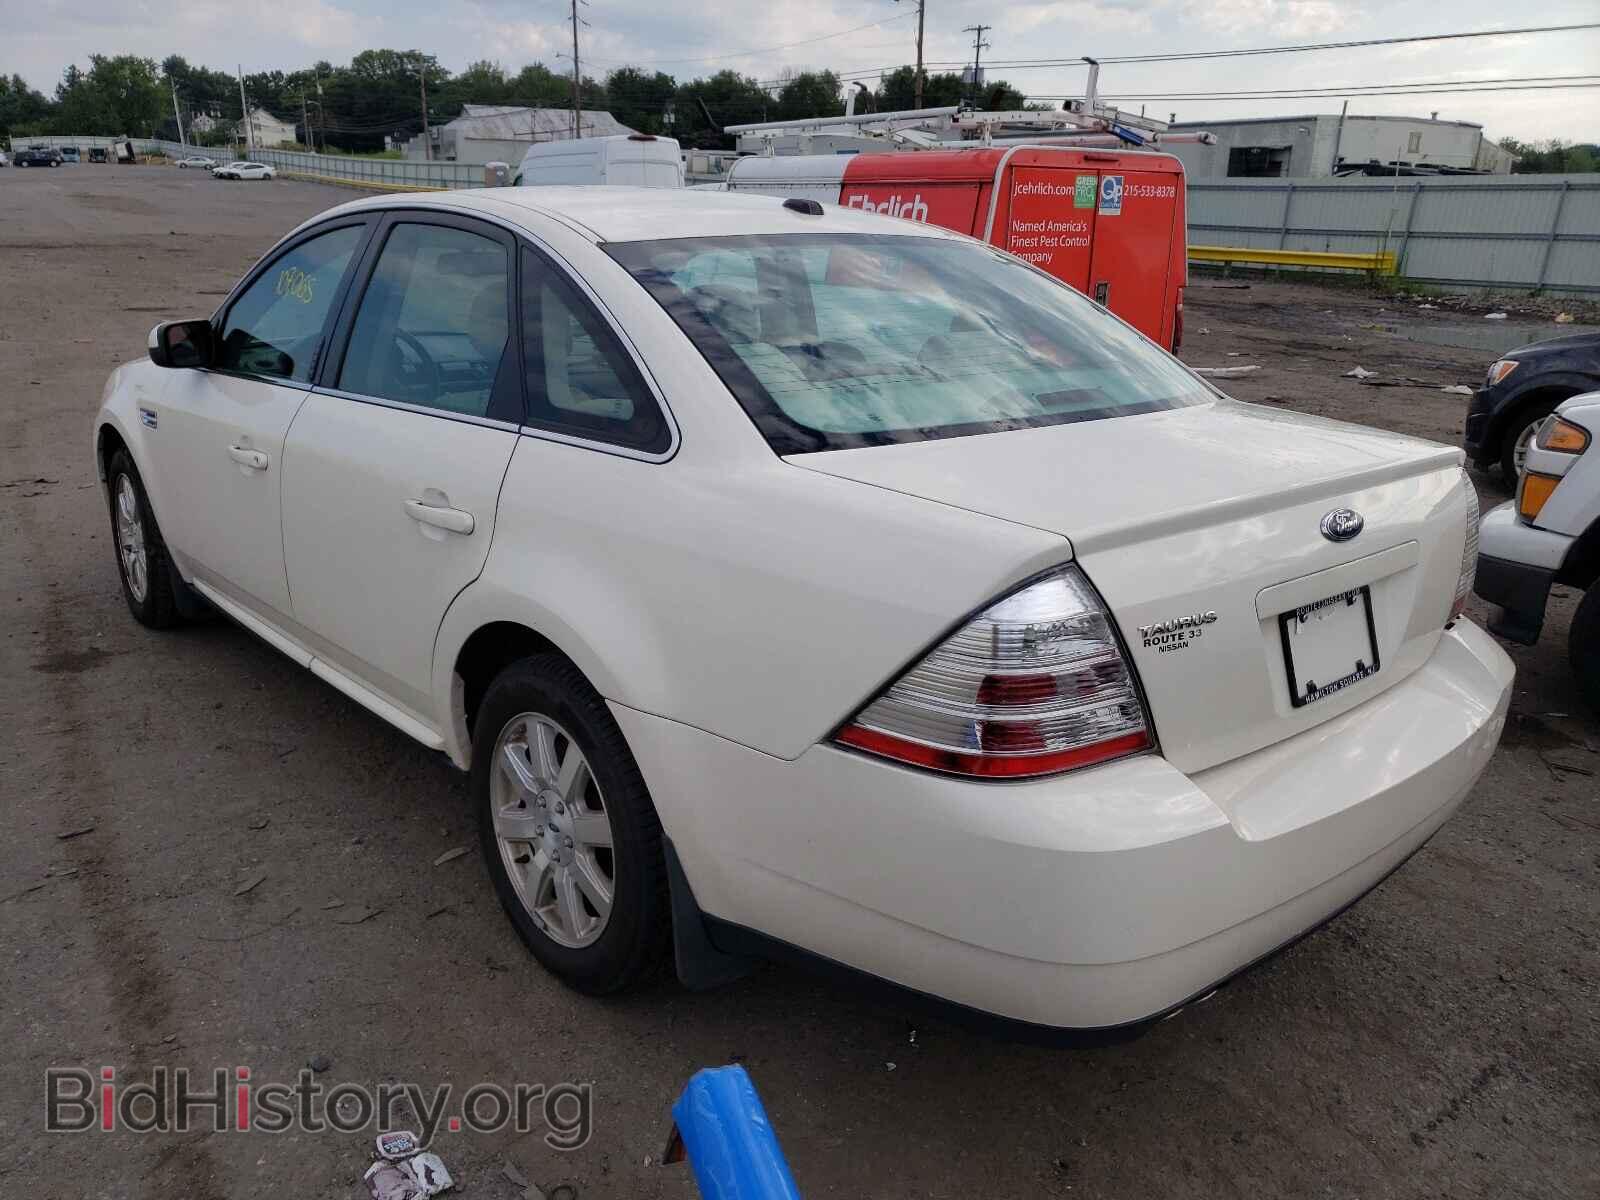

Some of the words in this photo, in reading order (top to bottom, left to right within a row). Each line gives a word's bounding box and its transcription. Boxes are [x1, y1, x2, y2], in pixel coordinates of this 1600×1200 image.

[1013, 181, 1075, 197] jcehrlich.com
[1124, 184, 1176, 198] 215-533-8378
[1012, 219, 1046, 233] Named
[1046, 220, 1088, 233] America's
[1011, 235, 1038, 248] Finest
[1039, 235, 1058, 248] Pest
[1059, 234, 1091, 248] Control
[1137, 609, 1218, 639] TAURUS
[1143, 632, 1185, 648] ROUTE
[1188, 628, 1203, 639] 33
[1158, 641, 1189, 654] NISSAN
